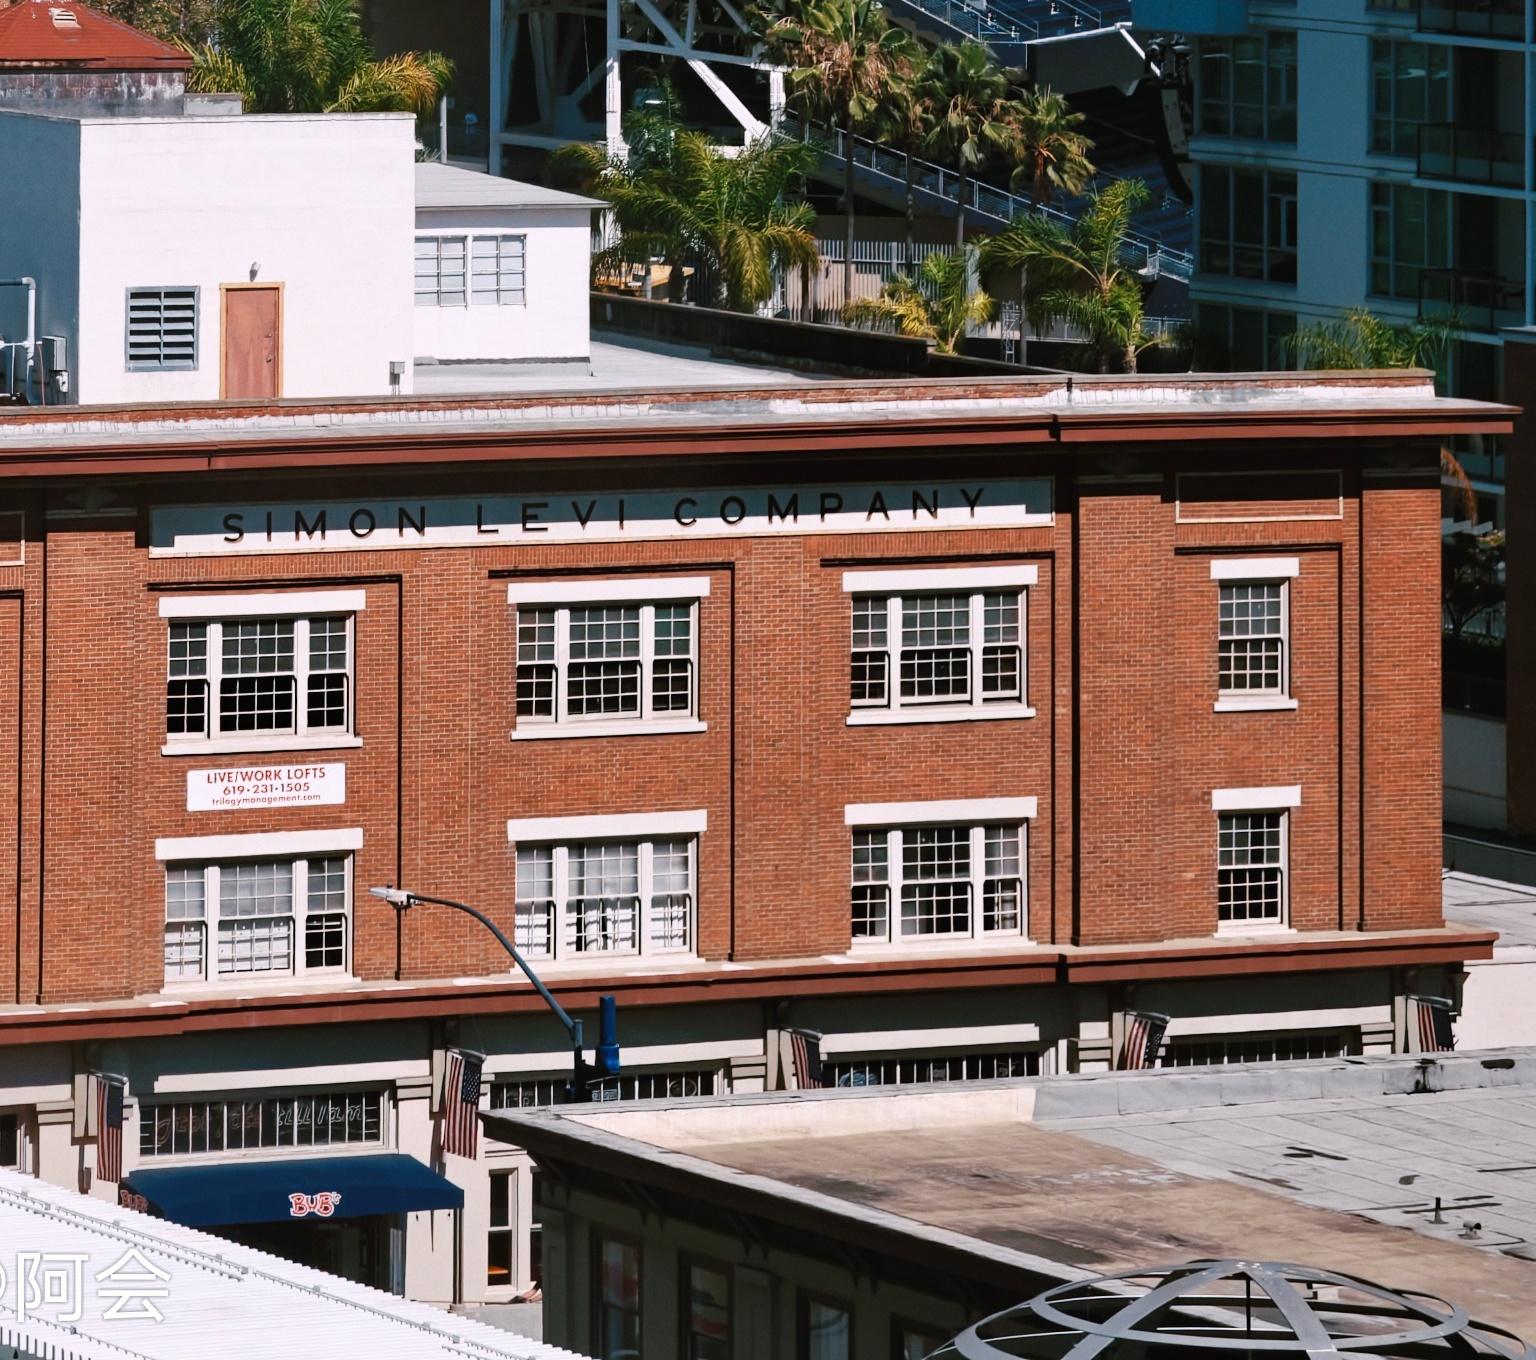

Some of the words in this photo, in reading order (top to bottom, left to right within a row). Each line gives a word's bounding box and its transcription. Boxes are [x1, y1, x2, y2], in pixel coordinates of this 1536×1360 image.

[222, 505, 427, 543] SIMON
[476, 498, 625, 535] LEVI
[673, 487, 984, 527] COMPANY
[206, 768, 283, 784] LIVE/WORK
[286, 766, 327, 780] LOFTS
[211, 793, 322, 807] trilogymanagement.com
